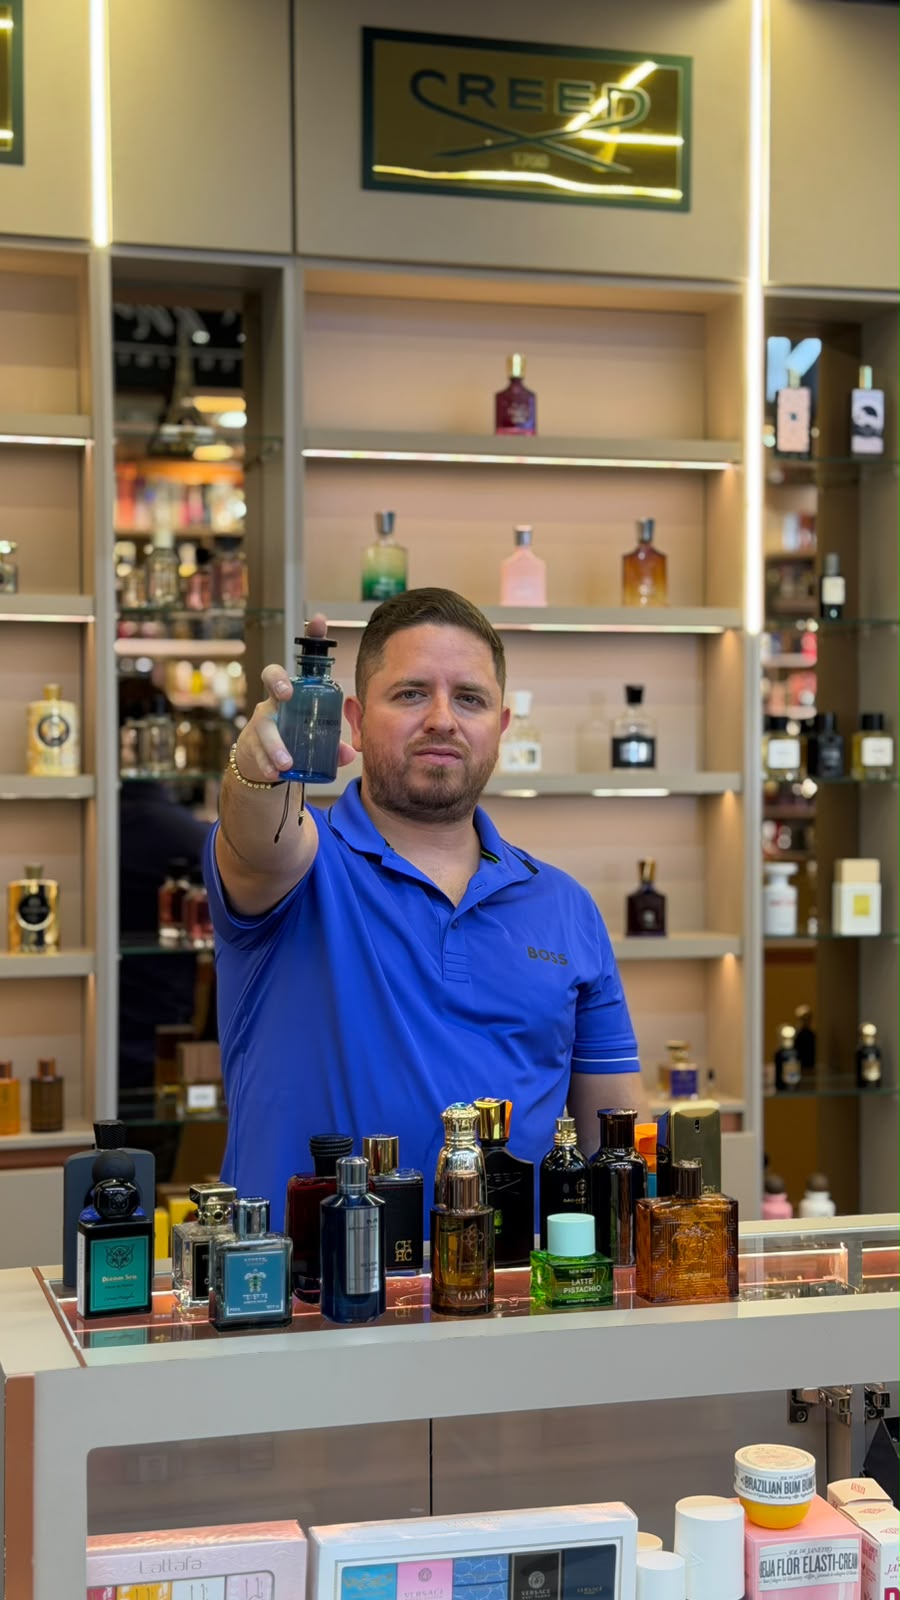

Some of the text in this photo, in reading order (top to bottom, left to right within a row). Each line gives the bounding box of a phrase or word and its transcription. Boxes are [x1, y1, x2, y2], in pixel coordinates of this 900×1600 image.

[410, 68, 651, 130] CREED
[527, 946, 568, 966] BOSS
[395, 1240, 412, 1251] CH
[395, 1250, 412, 1262] HC
[563, 1285, 602, 1294] PISTACHIO
[571, 1278, 593, 1286] LATTE
[744, 1475, 782, 1495] BRAZILIAN
[783, 1480, 800, 1495] BUM
[139, 1556, 202, 1574] Lattafa
[777, 1556, 800, 1577] FLOR
